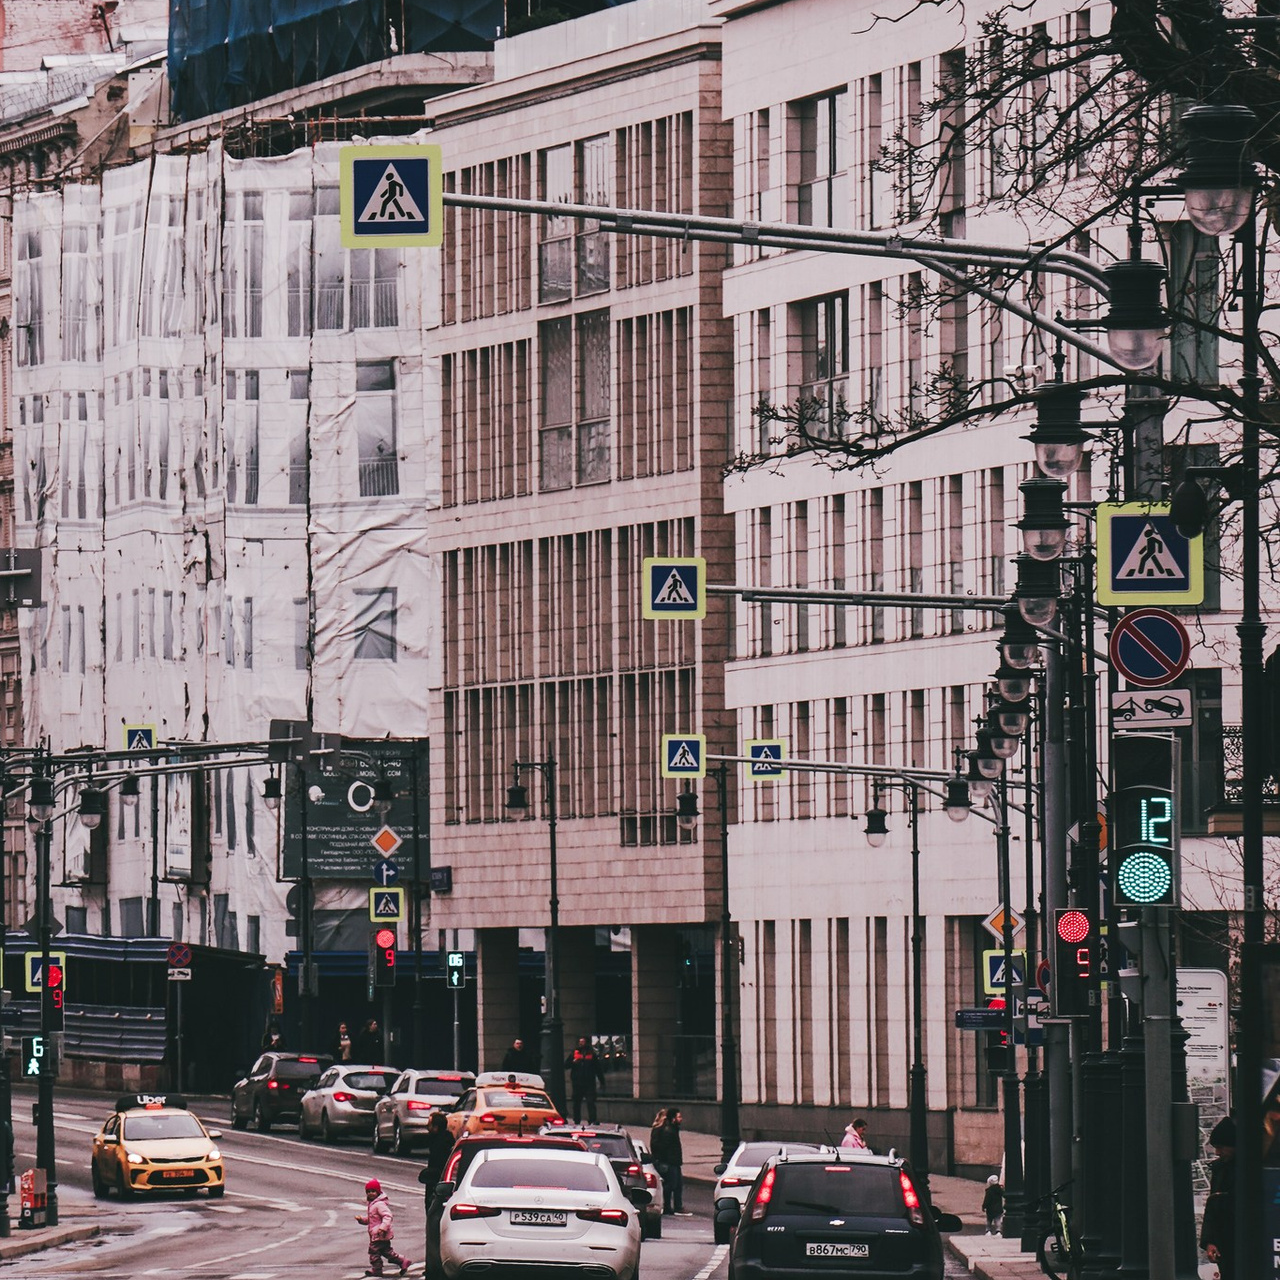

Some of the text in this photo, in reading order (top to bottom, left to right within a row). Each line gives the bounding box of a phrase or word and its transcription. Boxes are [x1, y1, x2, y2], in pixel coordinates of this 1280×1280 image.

[1141, 797, 1171, 843] 12
[385, 949, 395, 967] 9
[448, 953, 463, 967] 06
[1076, 948, 1090, 978] 9
[52, 989, 63, 1009] 9
[32, 1036, 44, 1058] 6
[136, 1095, 167, 1105] Uber
